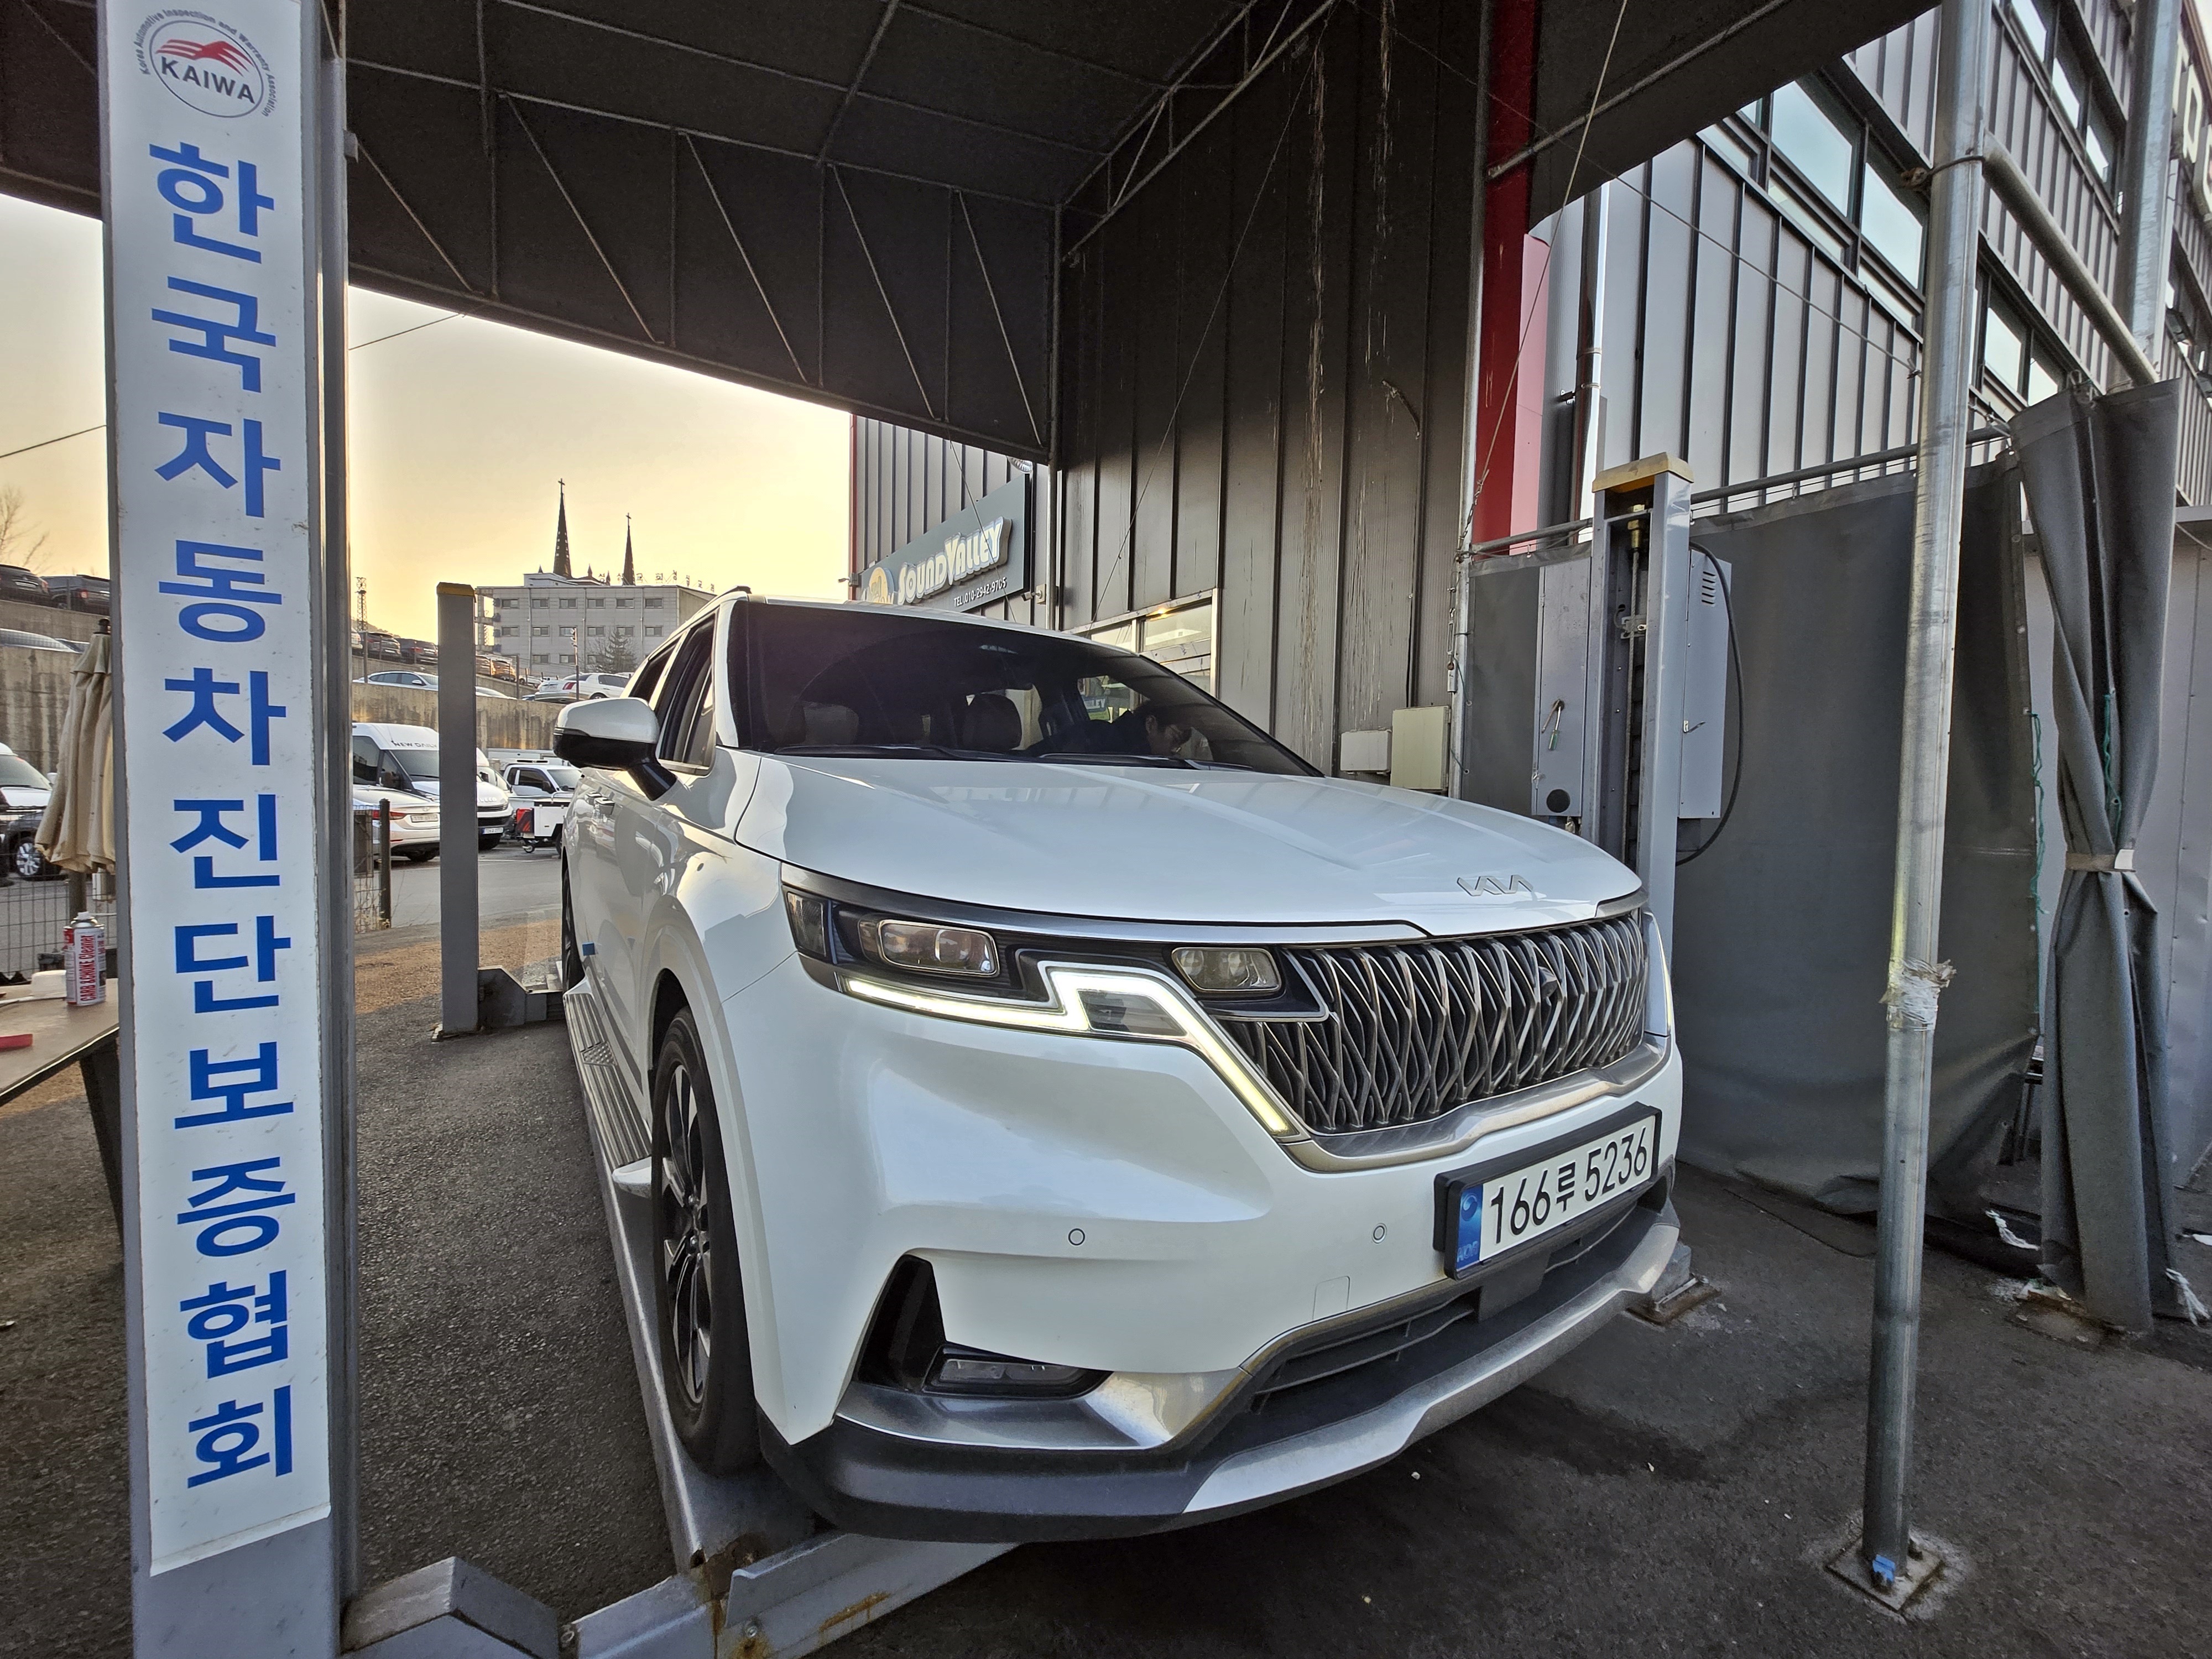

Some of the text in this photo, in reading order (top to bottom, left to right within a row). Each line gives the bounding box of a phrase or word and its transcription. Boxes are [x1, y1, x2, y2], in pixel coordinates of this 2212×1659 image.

[135, 49, 151, 75] Korea
[162, 9, 216, 23] Inspection
[218, 21, 237, 35] and
[238, 33, 270, 71] Warranty
[261, 72, 278, 117] Association
[161, 56, 255, 105] KAIWA
[149, 142, 295, 1489] 한국자동차진단보증협회
[1457, 874, 1533, 896] KIA
[80, 985, 97, 1001] CARB
[1490, 1126, 1647, 1244] 166루 5236
